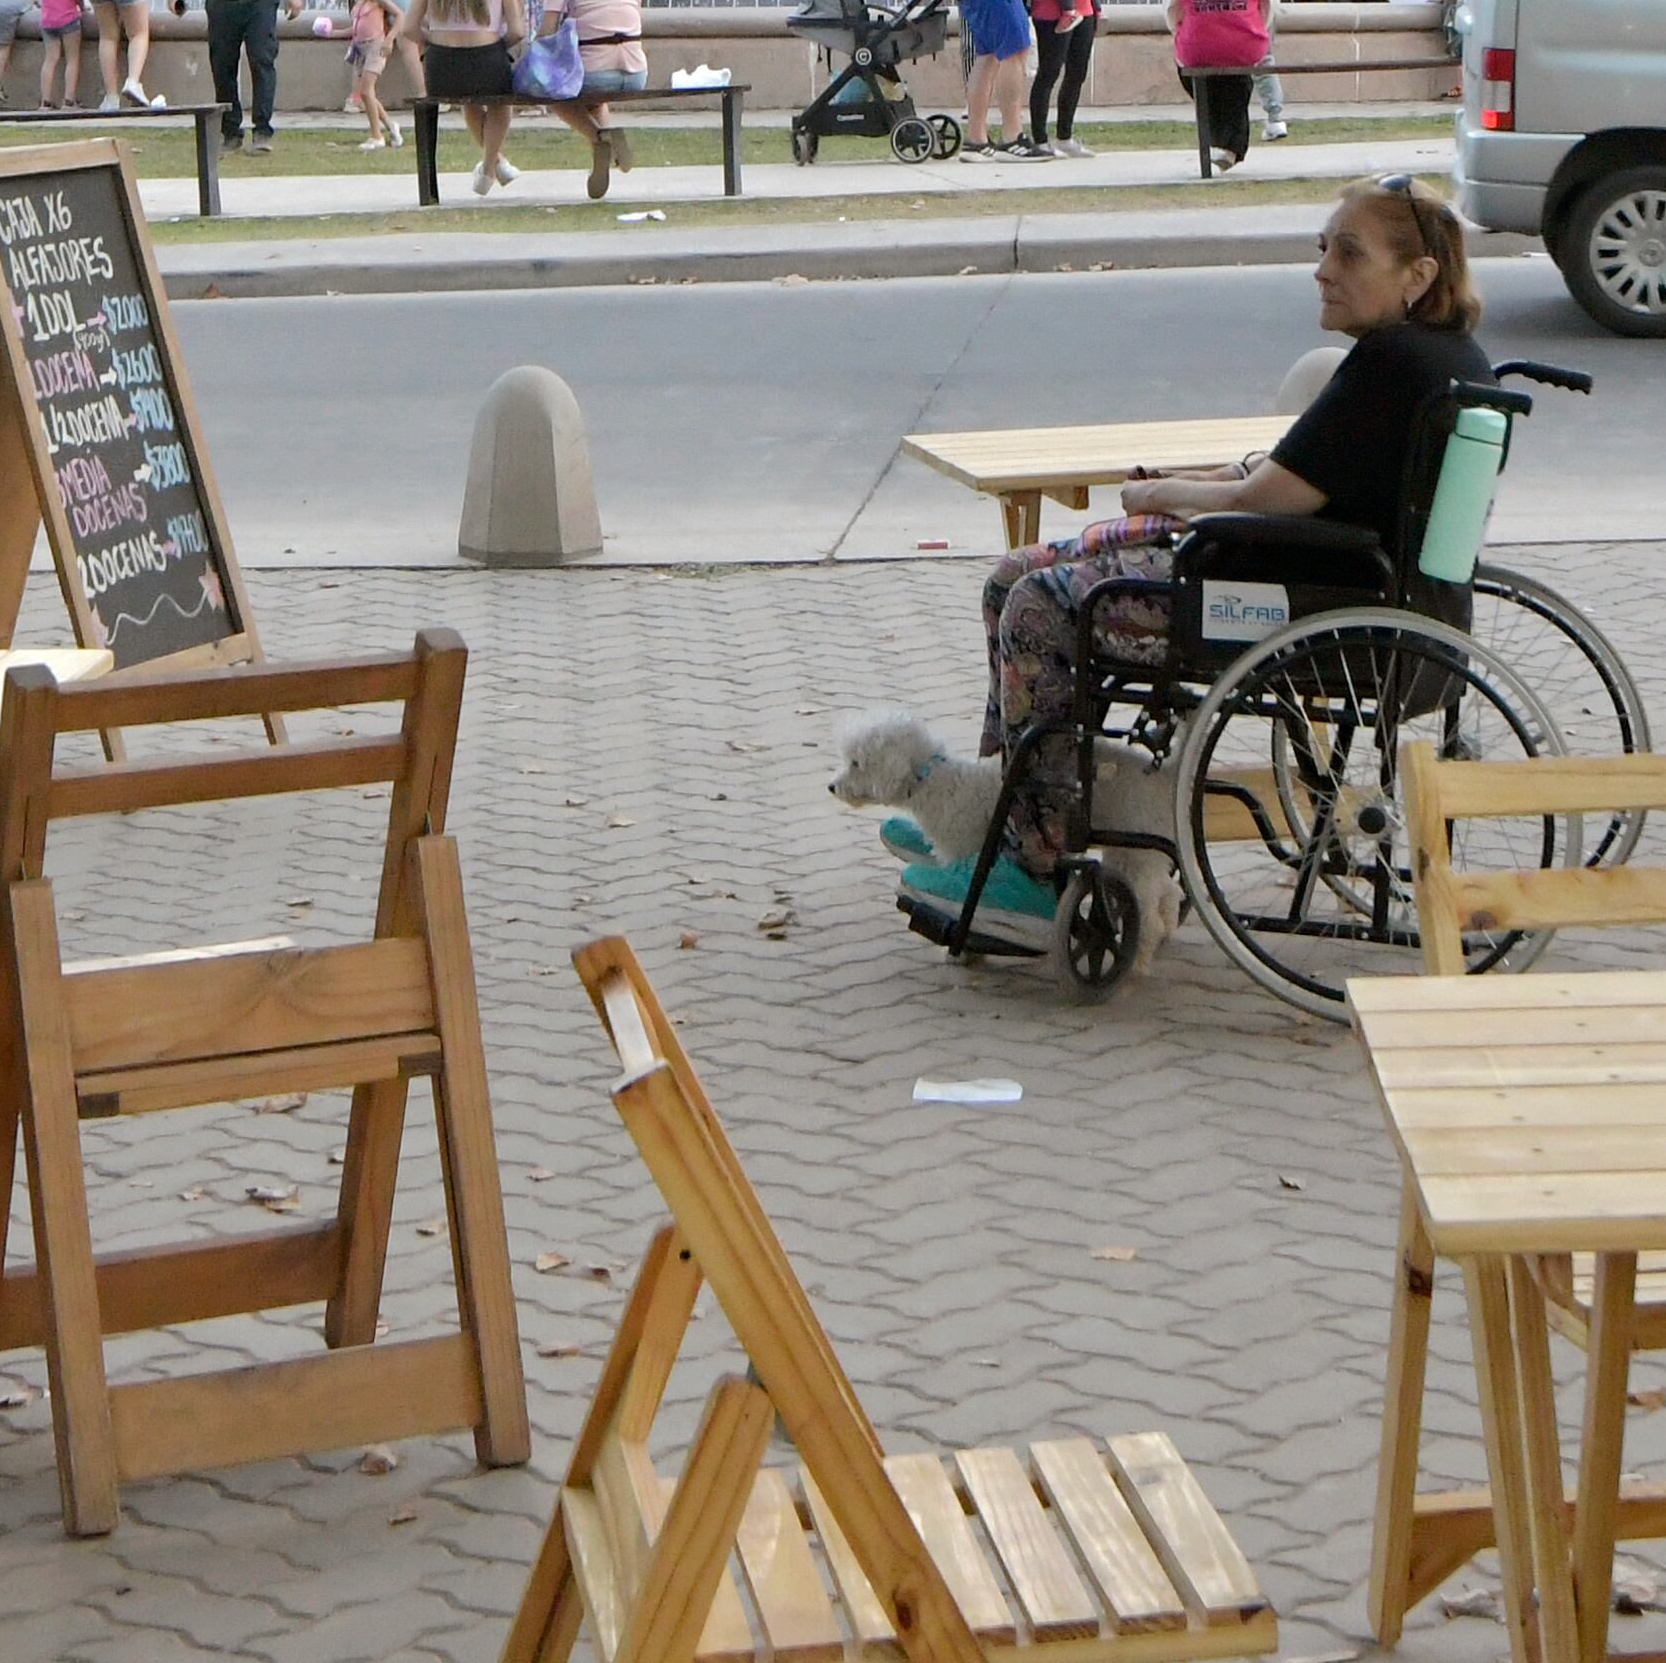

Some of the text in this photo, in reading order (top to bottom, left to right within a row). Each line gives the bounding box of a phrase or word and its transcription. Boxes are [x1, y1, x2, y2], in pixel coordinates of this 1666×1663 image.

[43, 190, 73, 234] X6
[8, 236, 114, 291] ALFAJORES
[101, 293, 149, 336] $2000
[111, 343, 163, 391] $2600
[71, 481, 148, 538] DOCENAS
[1209, 603, 1286, 622] SILFAB
